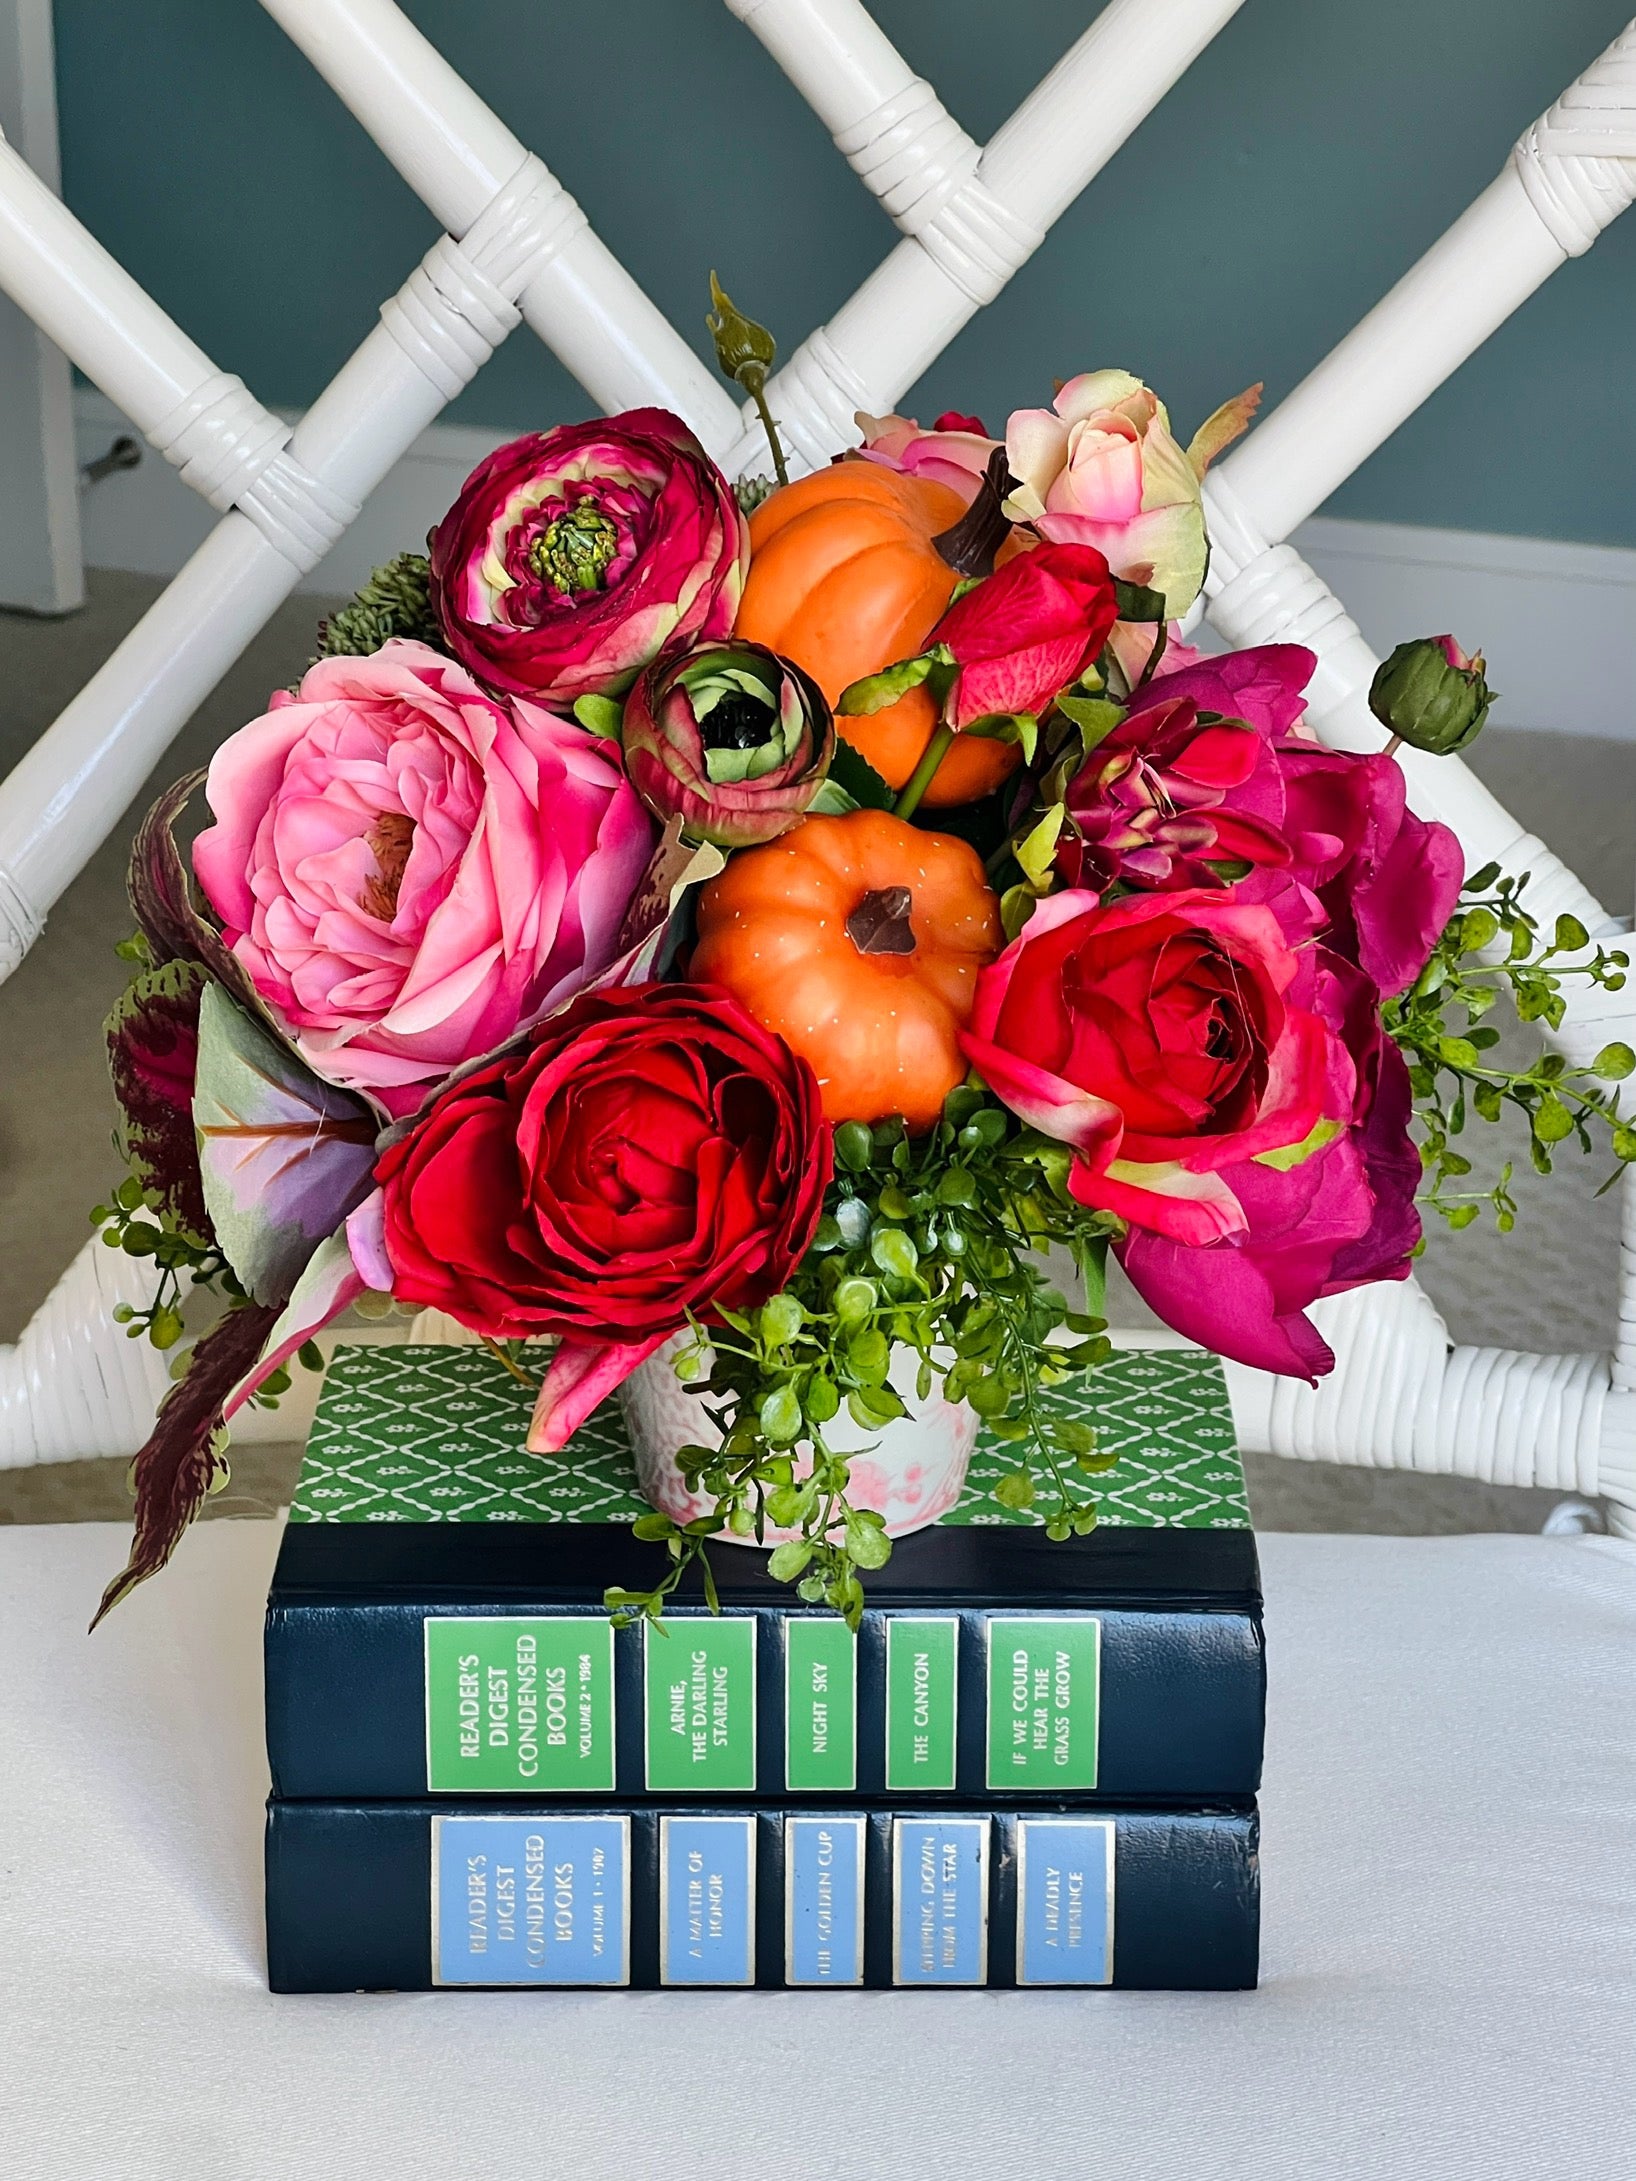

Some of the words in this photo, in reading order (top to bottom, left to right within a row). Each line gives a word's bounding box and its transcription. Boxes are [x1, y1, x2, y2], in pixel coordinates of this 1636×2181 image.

[579, 1654, 591, 1682] 1984
[692, 1651, 707, 1726] DARLING
[812, 1662, 827, 1692] SKY
[914, 1653, 929, 1726] CANYON
[1013, 1649, 1029, 1712] COULD
[1034, 1668, 1049, 1699] THE
[1055, 1651, 1070, 1709] GROW
[458, 1655, 479, 1757] READER'S
[488, 1666, 508, 1746] DIGEST
[516, 1634, 538, 1776] CONDENSED
[546, 1667, 566, 1745] BOOKS
[579, 1702, 592, 1758] VOLUME
[670, 1680, 688, 1735] ARNIE,
[713, 1667, 728, 1746] STARLING
[813, 1701, 827, 1752] NIGHT
[1013, 1720, 1028, 1744] WE
[1033, 1708, 1048, 1749] HEAR
[692, 1732, 706, 1762] THE
[914, 1735, 928, 1763] THE
[1013, 1752, 1027, 1765] IF
[1054, 1717, 1070, 1765] GRASS
[689, 1851, 703, 1872] OF
[818, 1831, 832, 1866] CUP
[922, 1837, 935, 1893] DOWN
[943, 1844, 957, 1881] STAR
[468, 1855, 487, 1952] READER'S
[496, 1865, 515, 1940] DIGEST
[526, 1835, 544, 1967] CONDENSED
[555, 1863, 573, 1940] BOOKS
[709, 1875, 723, 1936] HONOR
[689, 1948, 701, 1958] A
[1046, 1938, 1057, 1947] A
